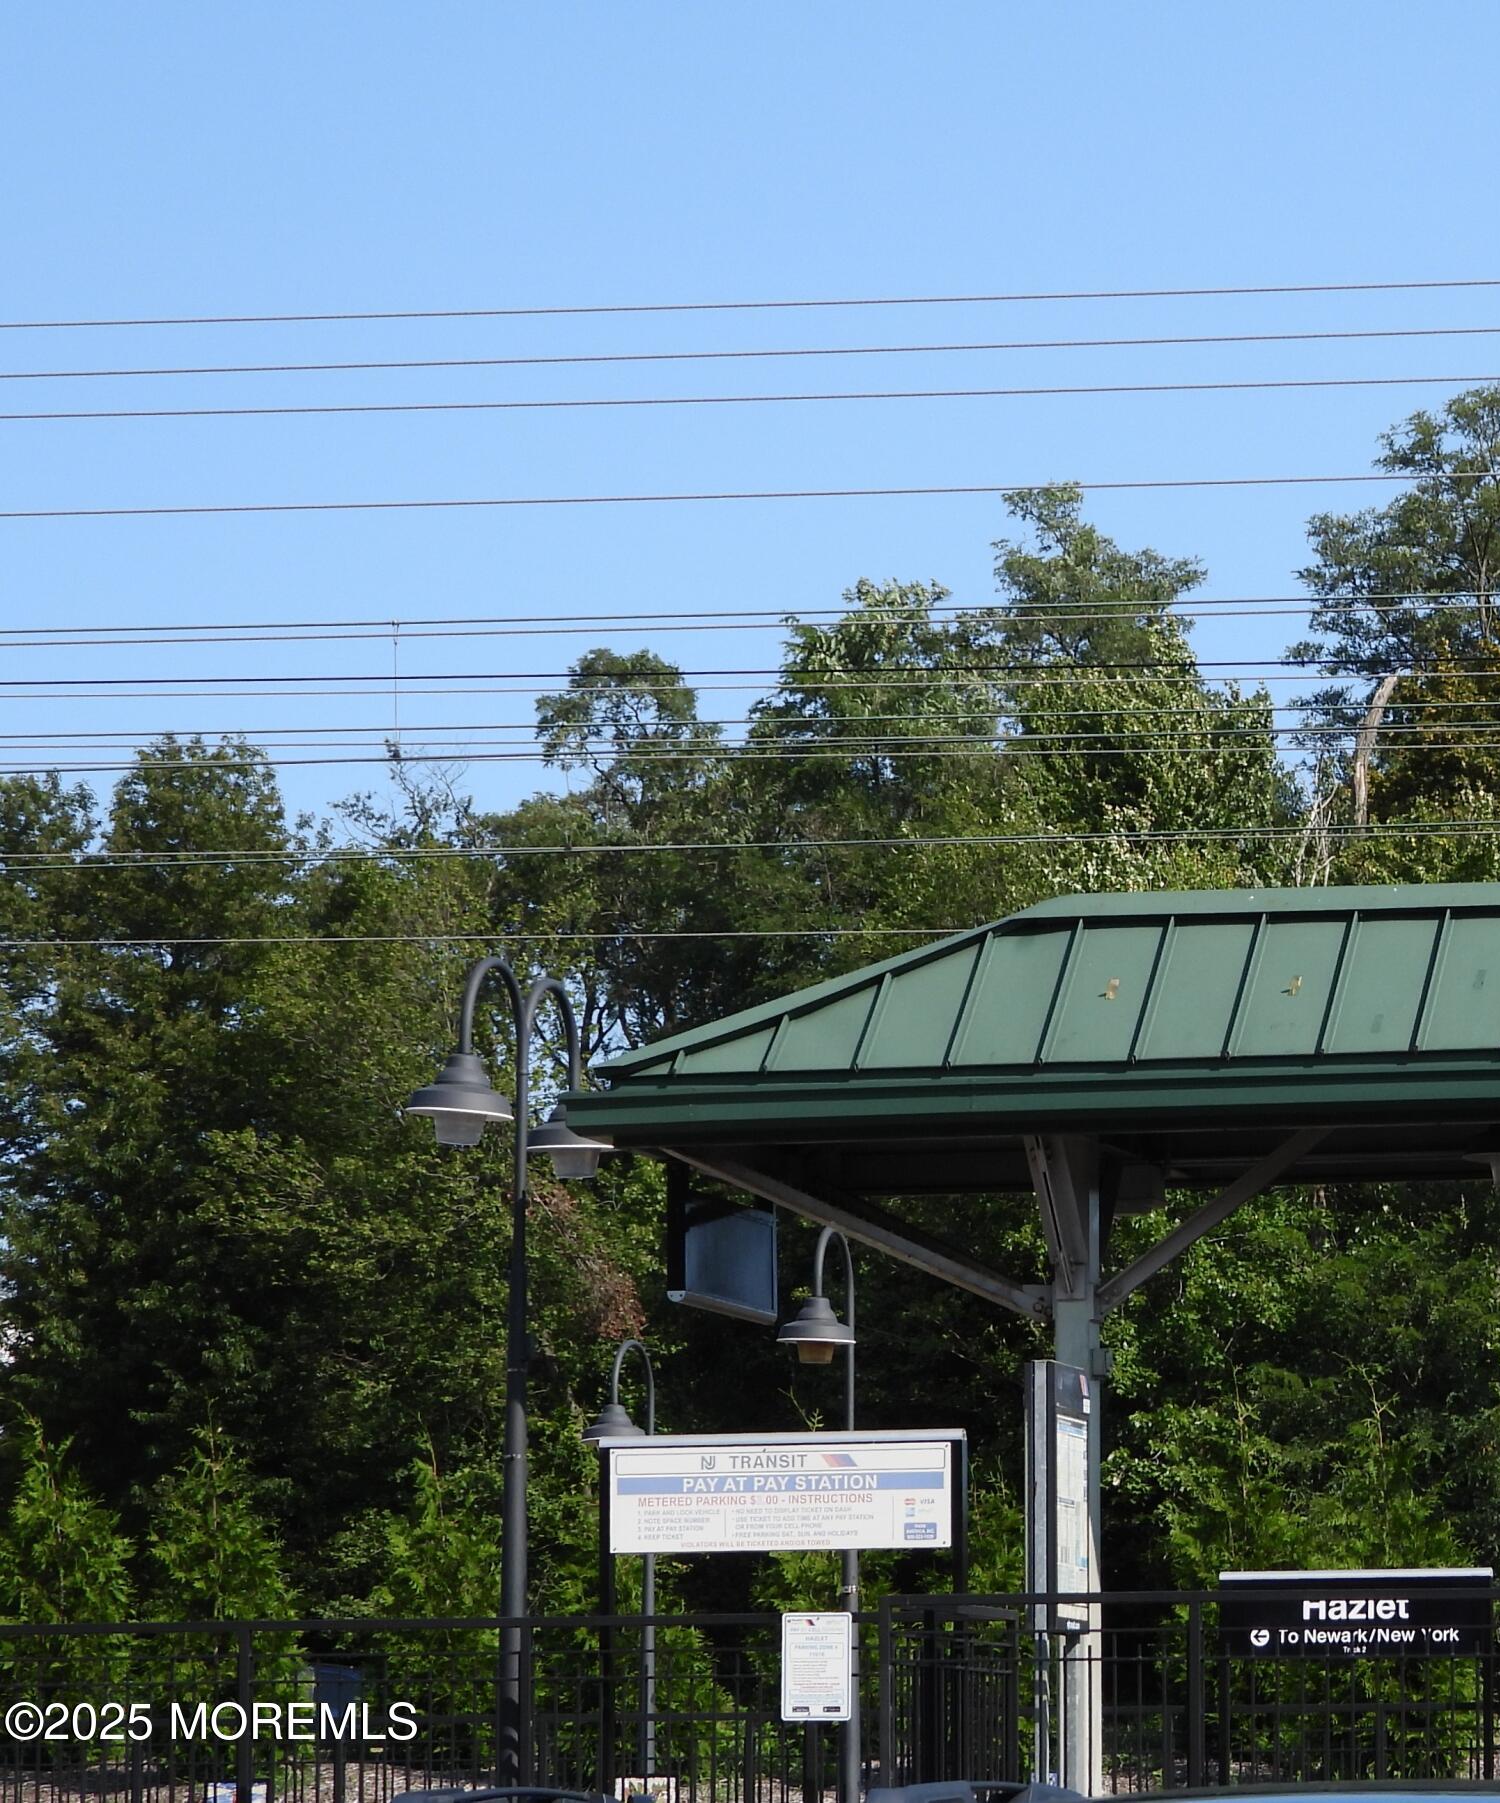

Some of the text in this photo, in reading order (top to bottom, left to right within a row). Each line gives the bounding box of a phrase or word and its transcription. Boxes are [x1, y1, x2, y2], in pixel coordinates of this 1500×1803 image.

[729, 1454, 808, 1470] TRANSIT
[683, 1474, 878, 1493] PAY AT PAY STATION
[638, 1497, 693, 1507] METERED
[696, 1495, 747, 1506] PARKING
[789, 1493, 873, 1504] INSTRUCTIONS
[1279, 1629, 1298, 1644] To
[1343, 1645, 1361, 1653] Trck
